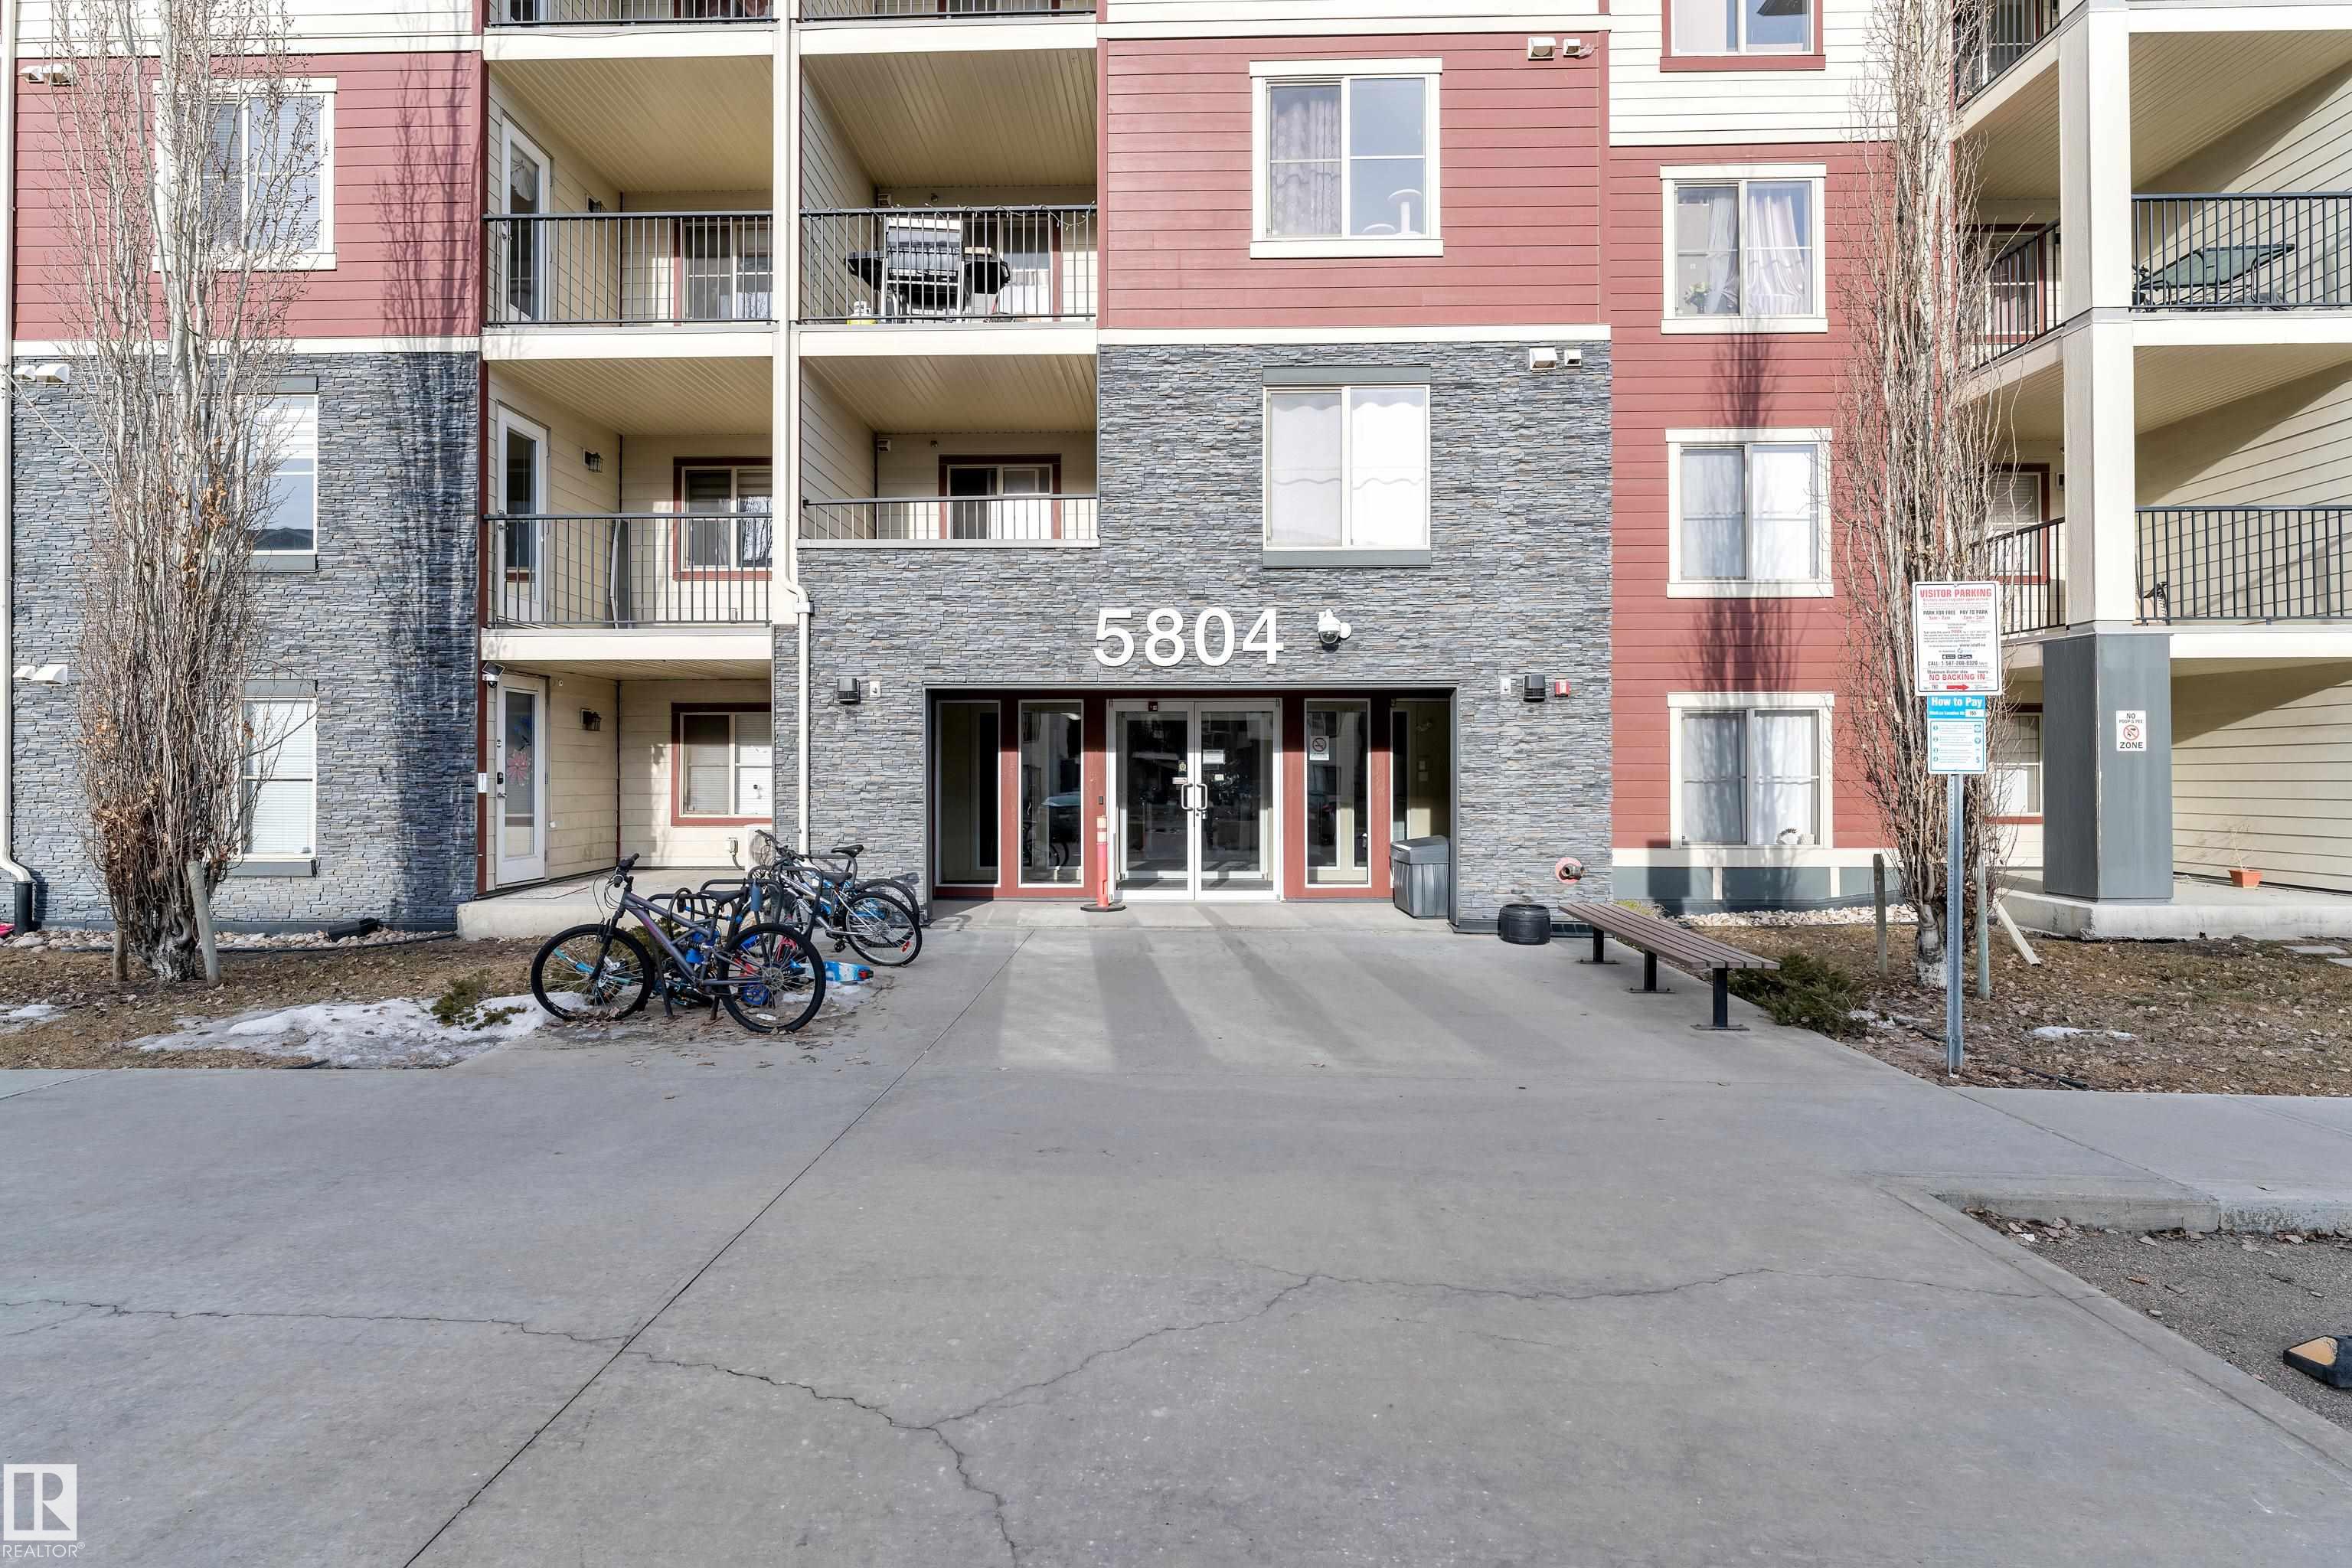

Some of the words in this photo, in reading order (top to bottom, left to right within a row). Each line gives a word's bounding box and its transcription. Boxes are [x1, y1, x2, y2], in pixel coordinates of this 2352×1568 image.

[1919, 589, 1952, 597] VISITOR
[1954, 588, 1991, 597] PARKING
[1093, 607, 1285, 667] 5804
[1931, 697, 1951, 706] How
[1953, 697, 1963, 706] to
[1965, 697, 1983, 708] Pay
